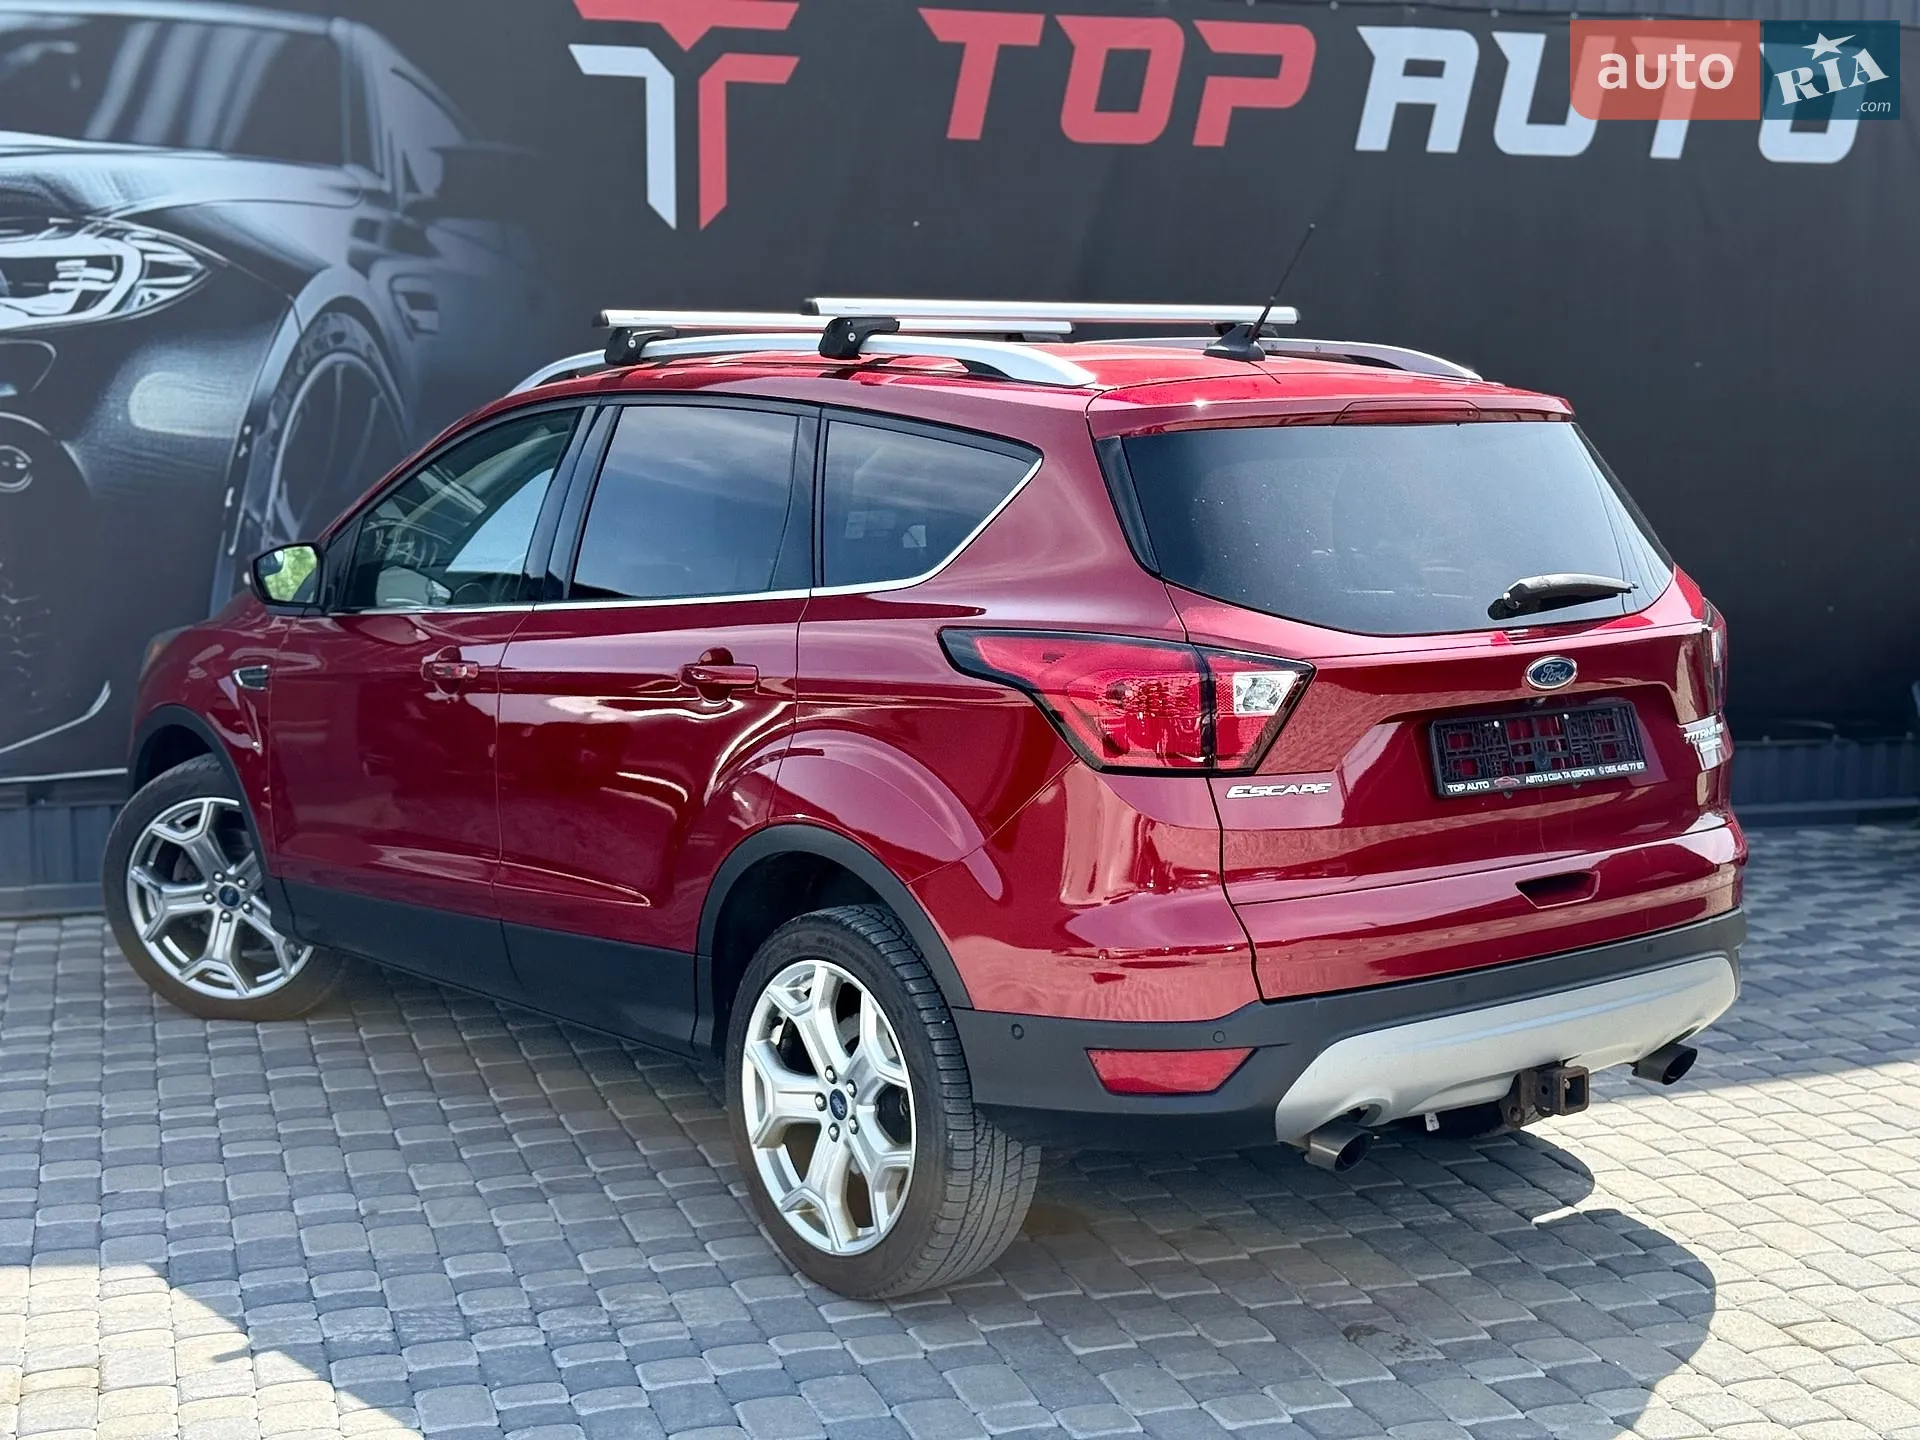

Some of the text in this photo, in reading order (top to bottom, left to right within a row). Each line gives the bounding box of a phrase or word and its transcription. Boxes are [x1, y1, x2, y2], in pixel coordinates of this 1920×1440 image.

[917, 7, 1869, 164] TOP AUTO
[1540, 663, 1568, 682] Ford
[1225, 782, 1333, 799] ESCAPE
[1447, 780, 1490, 793] TOP AUTO
